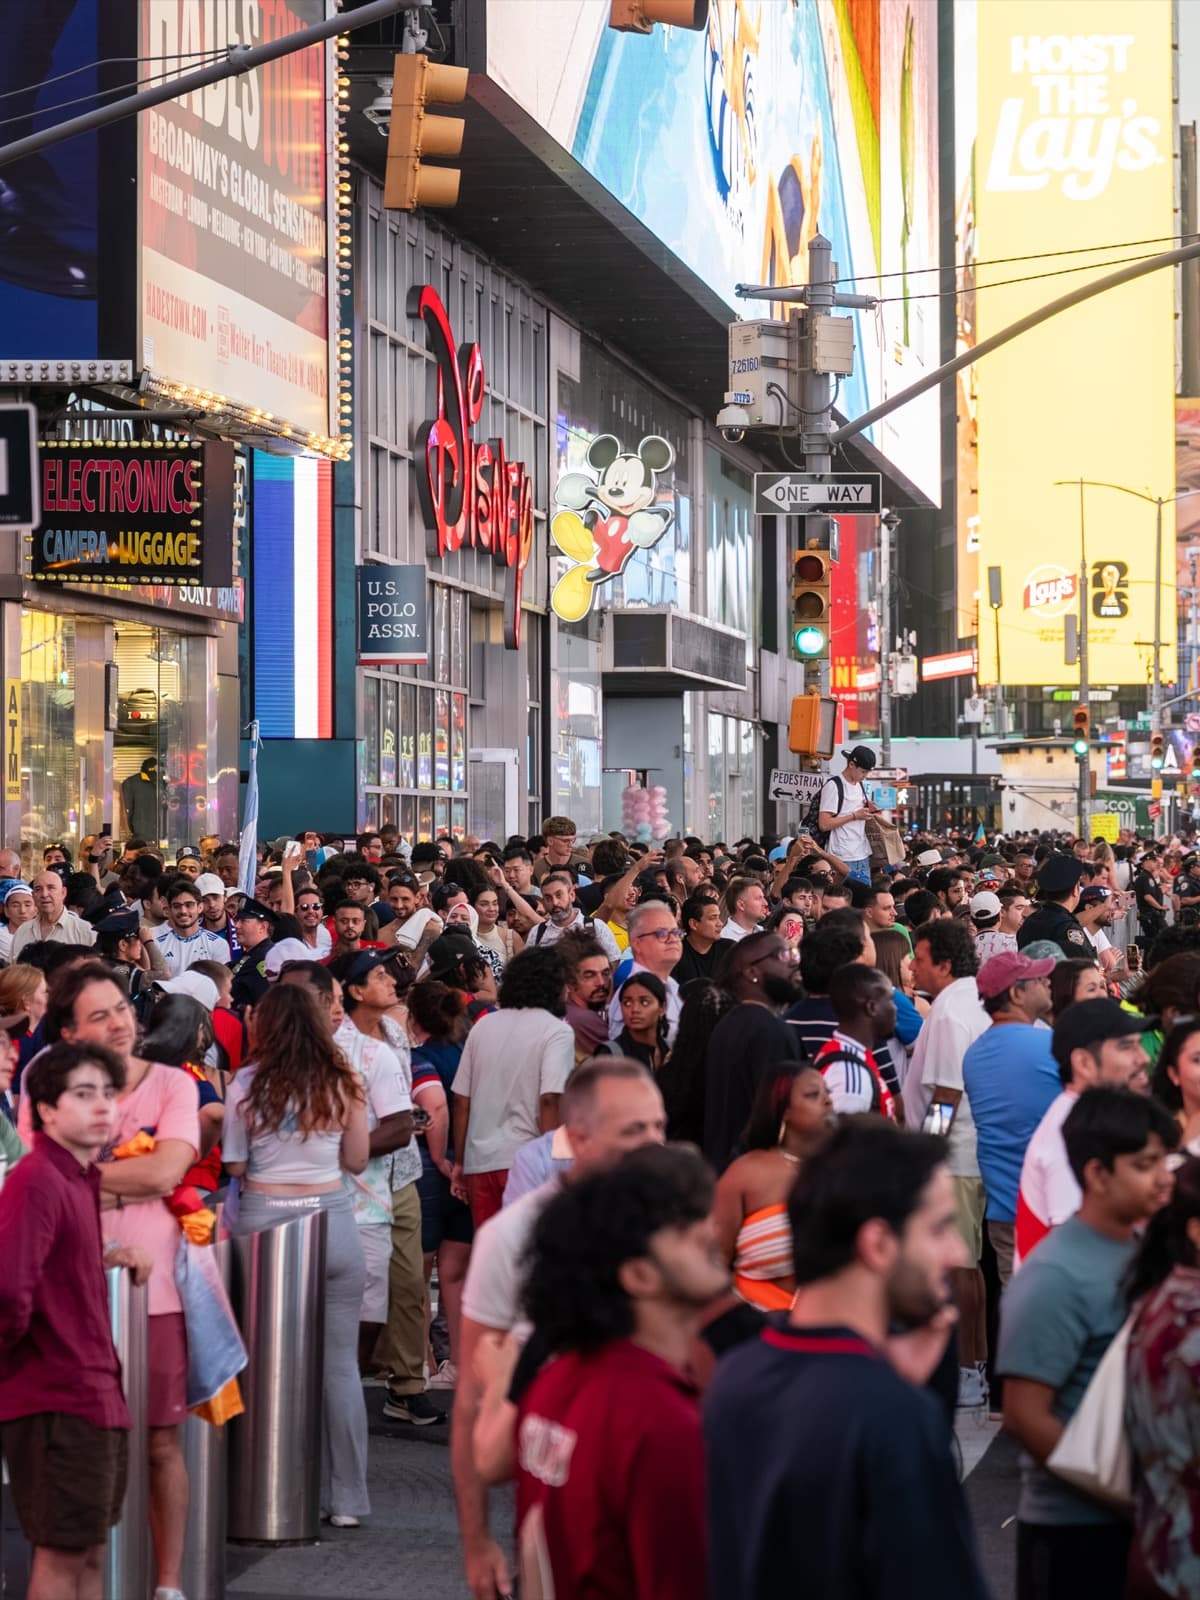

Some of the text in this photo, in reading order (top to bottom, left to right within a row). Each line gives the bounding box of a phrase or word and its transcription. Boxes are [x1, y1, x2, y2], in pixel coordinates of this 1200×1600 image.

[1010, 34, 1134, 73] HOIST
[1032, 75, 1109, 115] THE
[985, 98, 1166, 200] Lay's
[150, 109, 228, 197] BROADWAY'S
[231, 160, 271, 225] GLOBAL
[731, 357, 759, 374] 726160
[733, 392, 751, 404] NYPD
[43, 459, 199, 513] ELECTRONICS
[775, 487, 864, 501] ONE WAY
[43, 530, 198, 565] CAMERA LUGGAGE
[179, 586, 212, 607] SONY
[367, 582, 399, 596] U.S.
[367, 603, 416, 618] POLO
[367, 623, 420, 638] ASSN.
[8, 685, 18, 782] ATM
[773, 772, 825, 788] PEDESTRIAN
